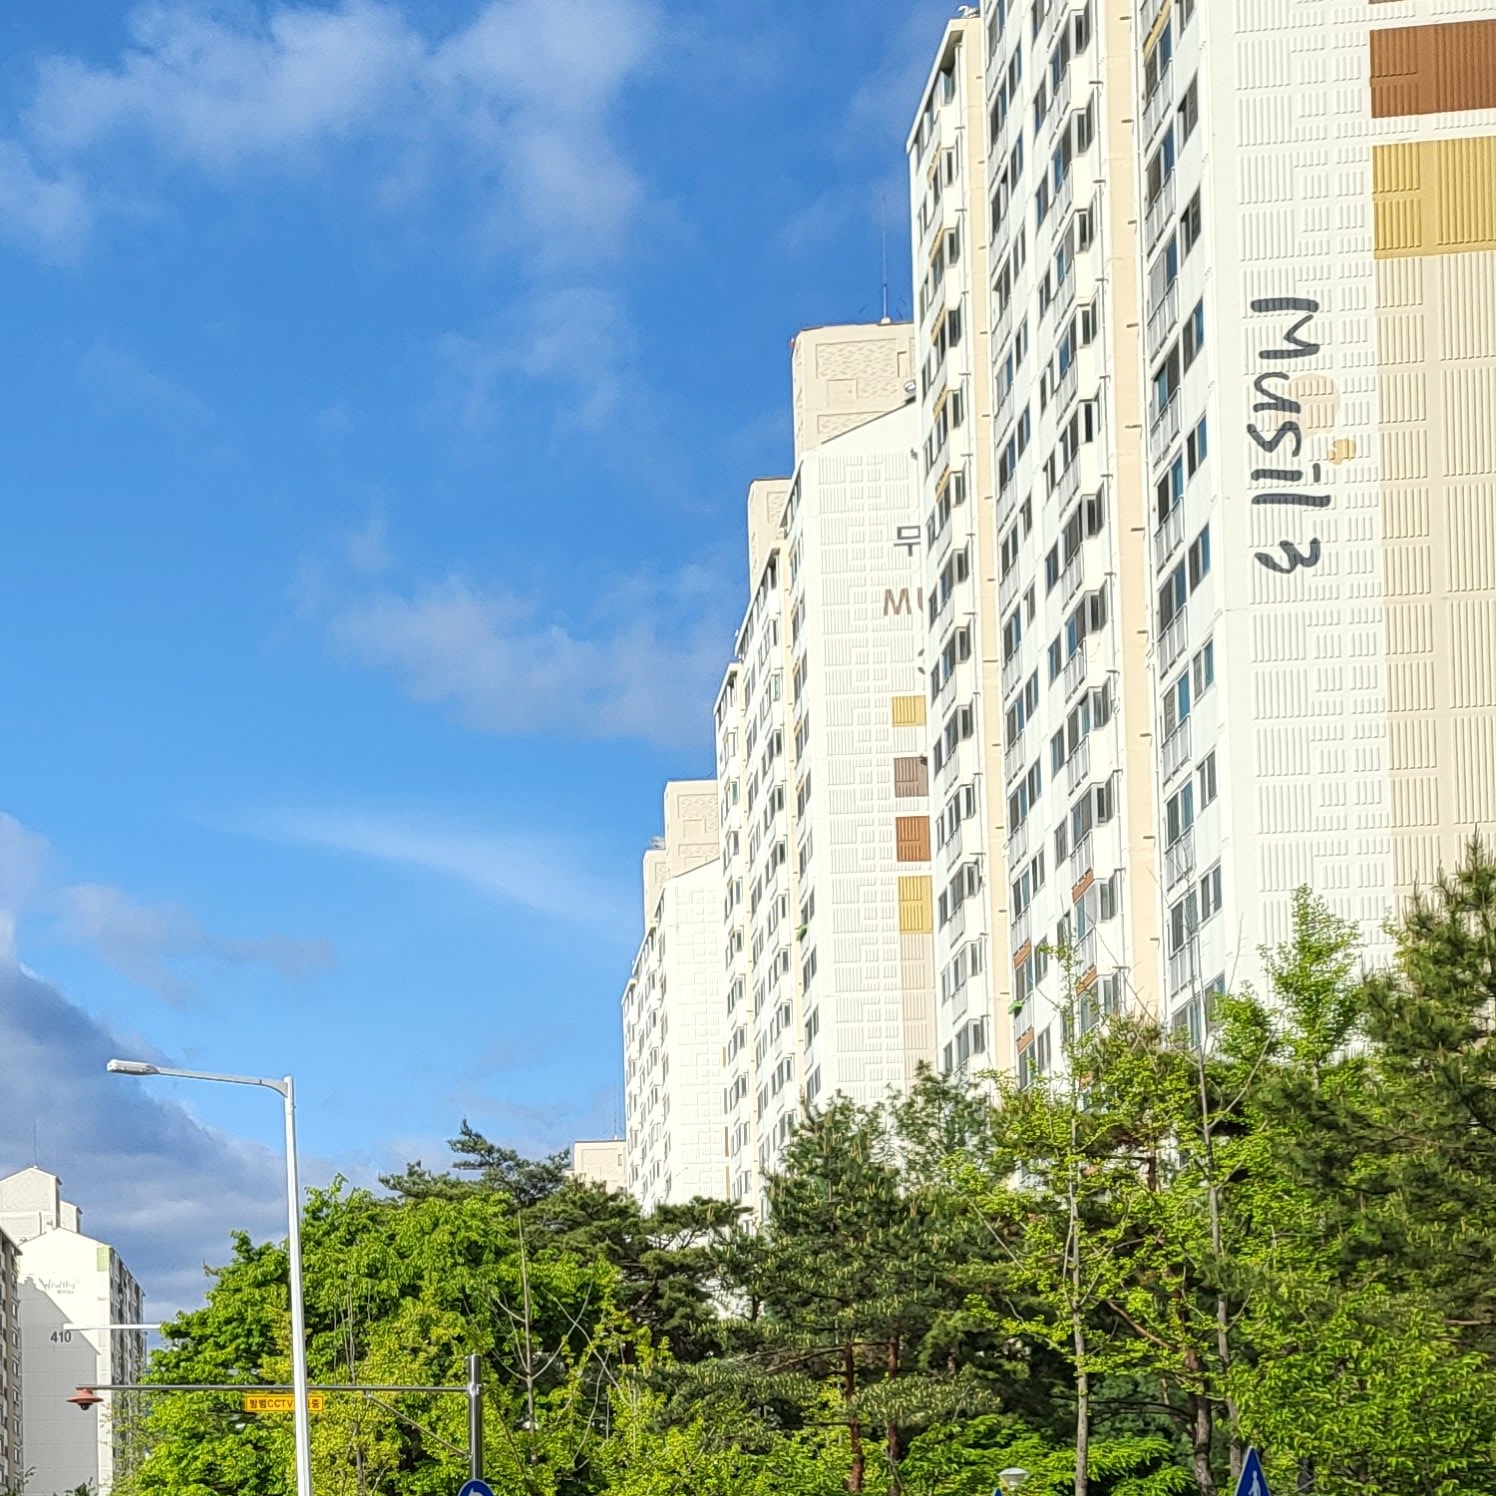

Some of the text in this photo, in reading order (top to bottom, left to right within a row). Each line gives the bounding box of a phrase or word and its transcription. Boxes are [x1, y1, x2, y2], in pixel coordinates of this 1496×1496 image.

[1247, 297, 1332, 574] Musil 3
[50, 1331, 72, 1343] 410
